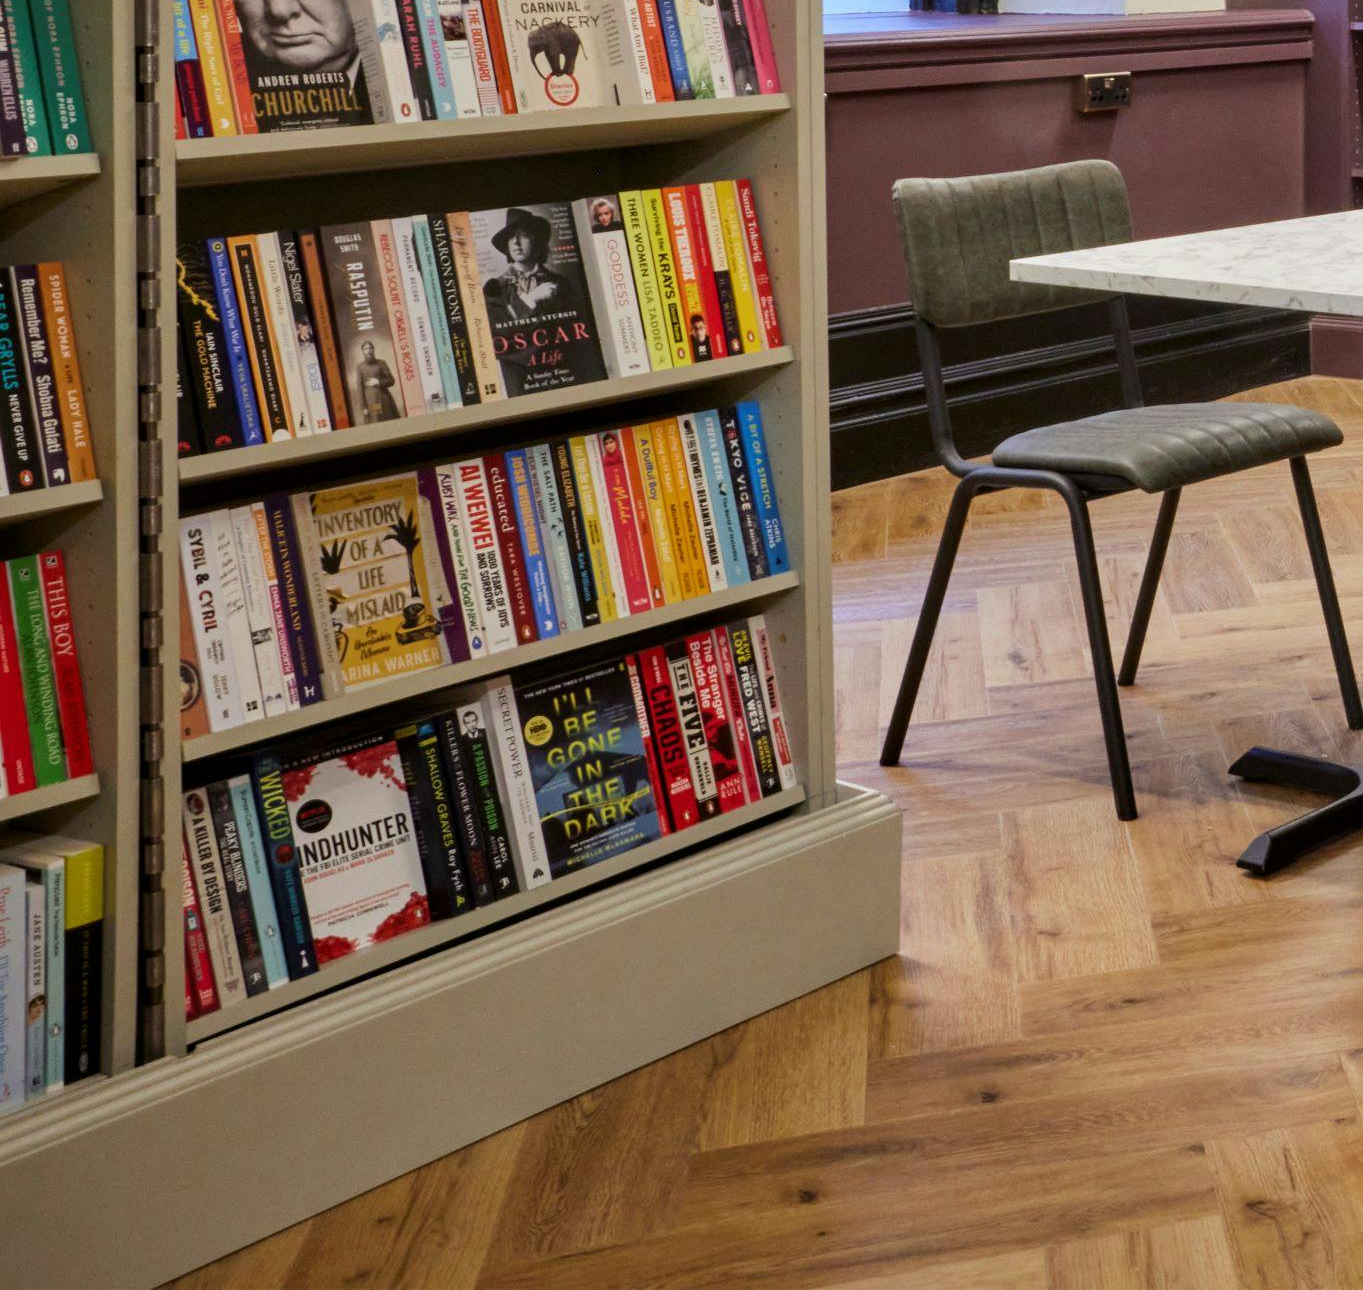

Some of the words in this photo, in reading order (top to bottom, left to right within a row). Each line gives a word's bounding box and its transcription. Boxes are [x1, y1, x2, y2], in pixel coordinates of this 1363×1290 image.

[515, 14, 600, 30] NACKERY
[521, 2, 581, 14] CARNIVAL
[410, 34, 420, 68] RUHL
[466, 8, 478, 27] THE
[472, 29, 491, 82] BODYGUARD
[258, 74, 299, 87] ANDREW
[302, 72, 344, 84] ROBERTS
[250, 89, 363, 118] CHURCHILL
[629, 198, 640, 231] THREE
[636, 232, 649, 278] WOMEN
[740, 187, 754, 216] Sandi
[747, 217, 762, 263] Toksvig
[284, 241, 298, 270] Nigel
[433, 220, 454, 275] SHARON
[444, 279, 462, 324] STONE
[288, 272, 304, 304] Slater
[607, 239, 630, 308] GODDESS
[659, 253, 677, 305] KRAYS
[49, 275, 64, 312] SPIDER
[346, 261, 374, 332] RASPUTIN
[21, 279, 42, 341] Remember
[33, 342, 48, 363] Me?
[496, 316, 539, 328] MATTHEW
[543, 310, 577, 321] STURGIS
[56, 318, 70, 359] WOMAN
[206, 332, 216, 353] IAIN
[493, 321, 591, 354] OSCAR
[209, 354, 224, 393] SINCLAIR
[529, 356, 537, 365] A
[541, 351, 563, 365] Life
[459, 465, 480, 482] AI
[724, 420, 742, 468] TOKYO
[736, 473, 752, 511] VICE
[440, 474, 454, 498] RUBY
[491, 467, 508, 533] educated
[318, 501, 401, 538] INVENTORY
[446, 500, 458, 521] WAX
[467, 484, 493, 550] WEIWEI
[350, 542, 368, 560] OF
[372, 540, 382, 557] A
[476, 553, 485, 569] AND
[487, 551, 496, 568] 1000
[188, 528, 201, 570] SYBIL
[195, 574, 204, 585] &
[200, 590, 218, 633] CYRIL
[359, 566, 384, 590] LIFE
[480, 570, 496, 612] SORROWS
[490, 569, 501, 591] YEARS
[48, 577, 67, 618] THIS
[346, 592, 406, 624] MISLAID
[496, 593, 502, 602] OF
[497, 603, 506, 628] JOYS
[53, 622, 74, 656] BOY
[385, 649, 440, 672] WARNER
[674, 663, 687, 691] THE
[691, 641, 704, 683] Beside
[699, 688, 708, 709] Me
[702, 638, 713, 660] The
[708, 664, 724, 720] Stranger
[563, 711, 598, 735] BE
[651, 684, 682, 764] CHAOS
[680, 694, 705, 752] FIVE
[547, 727, 622, 770] GONE
[579, 760, 602, 783] IN
[259, 770, 292, 840] WICKED
[426, 747, 445, 798] SHALLOW
[437, 802, 453, 846] GRAVES
[569, 777, 622, 807] THE
[563, 798, 634, 839] DARK
[299, 812, 409, 865] INDHUNTER
